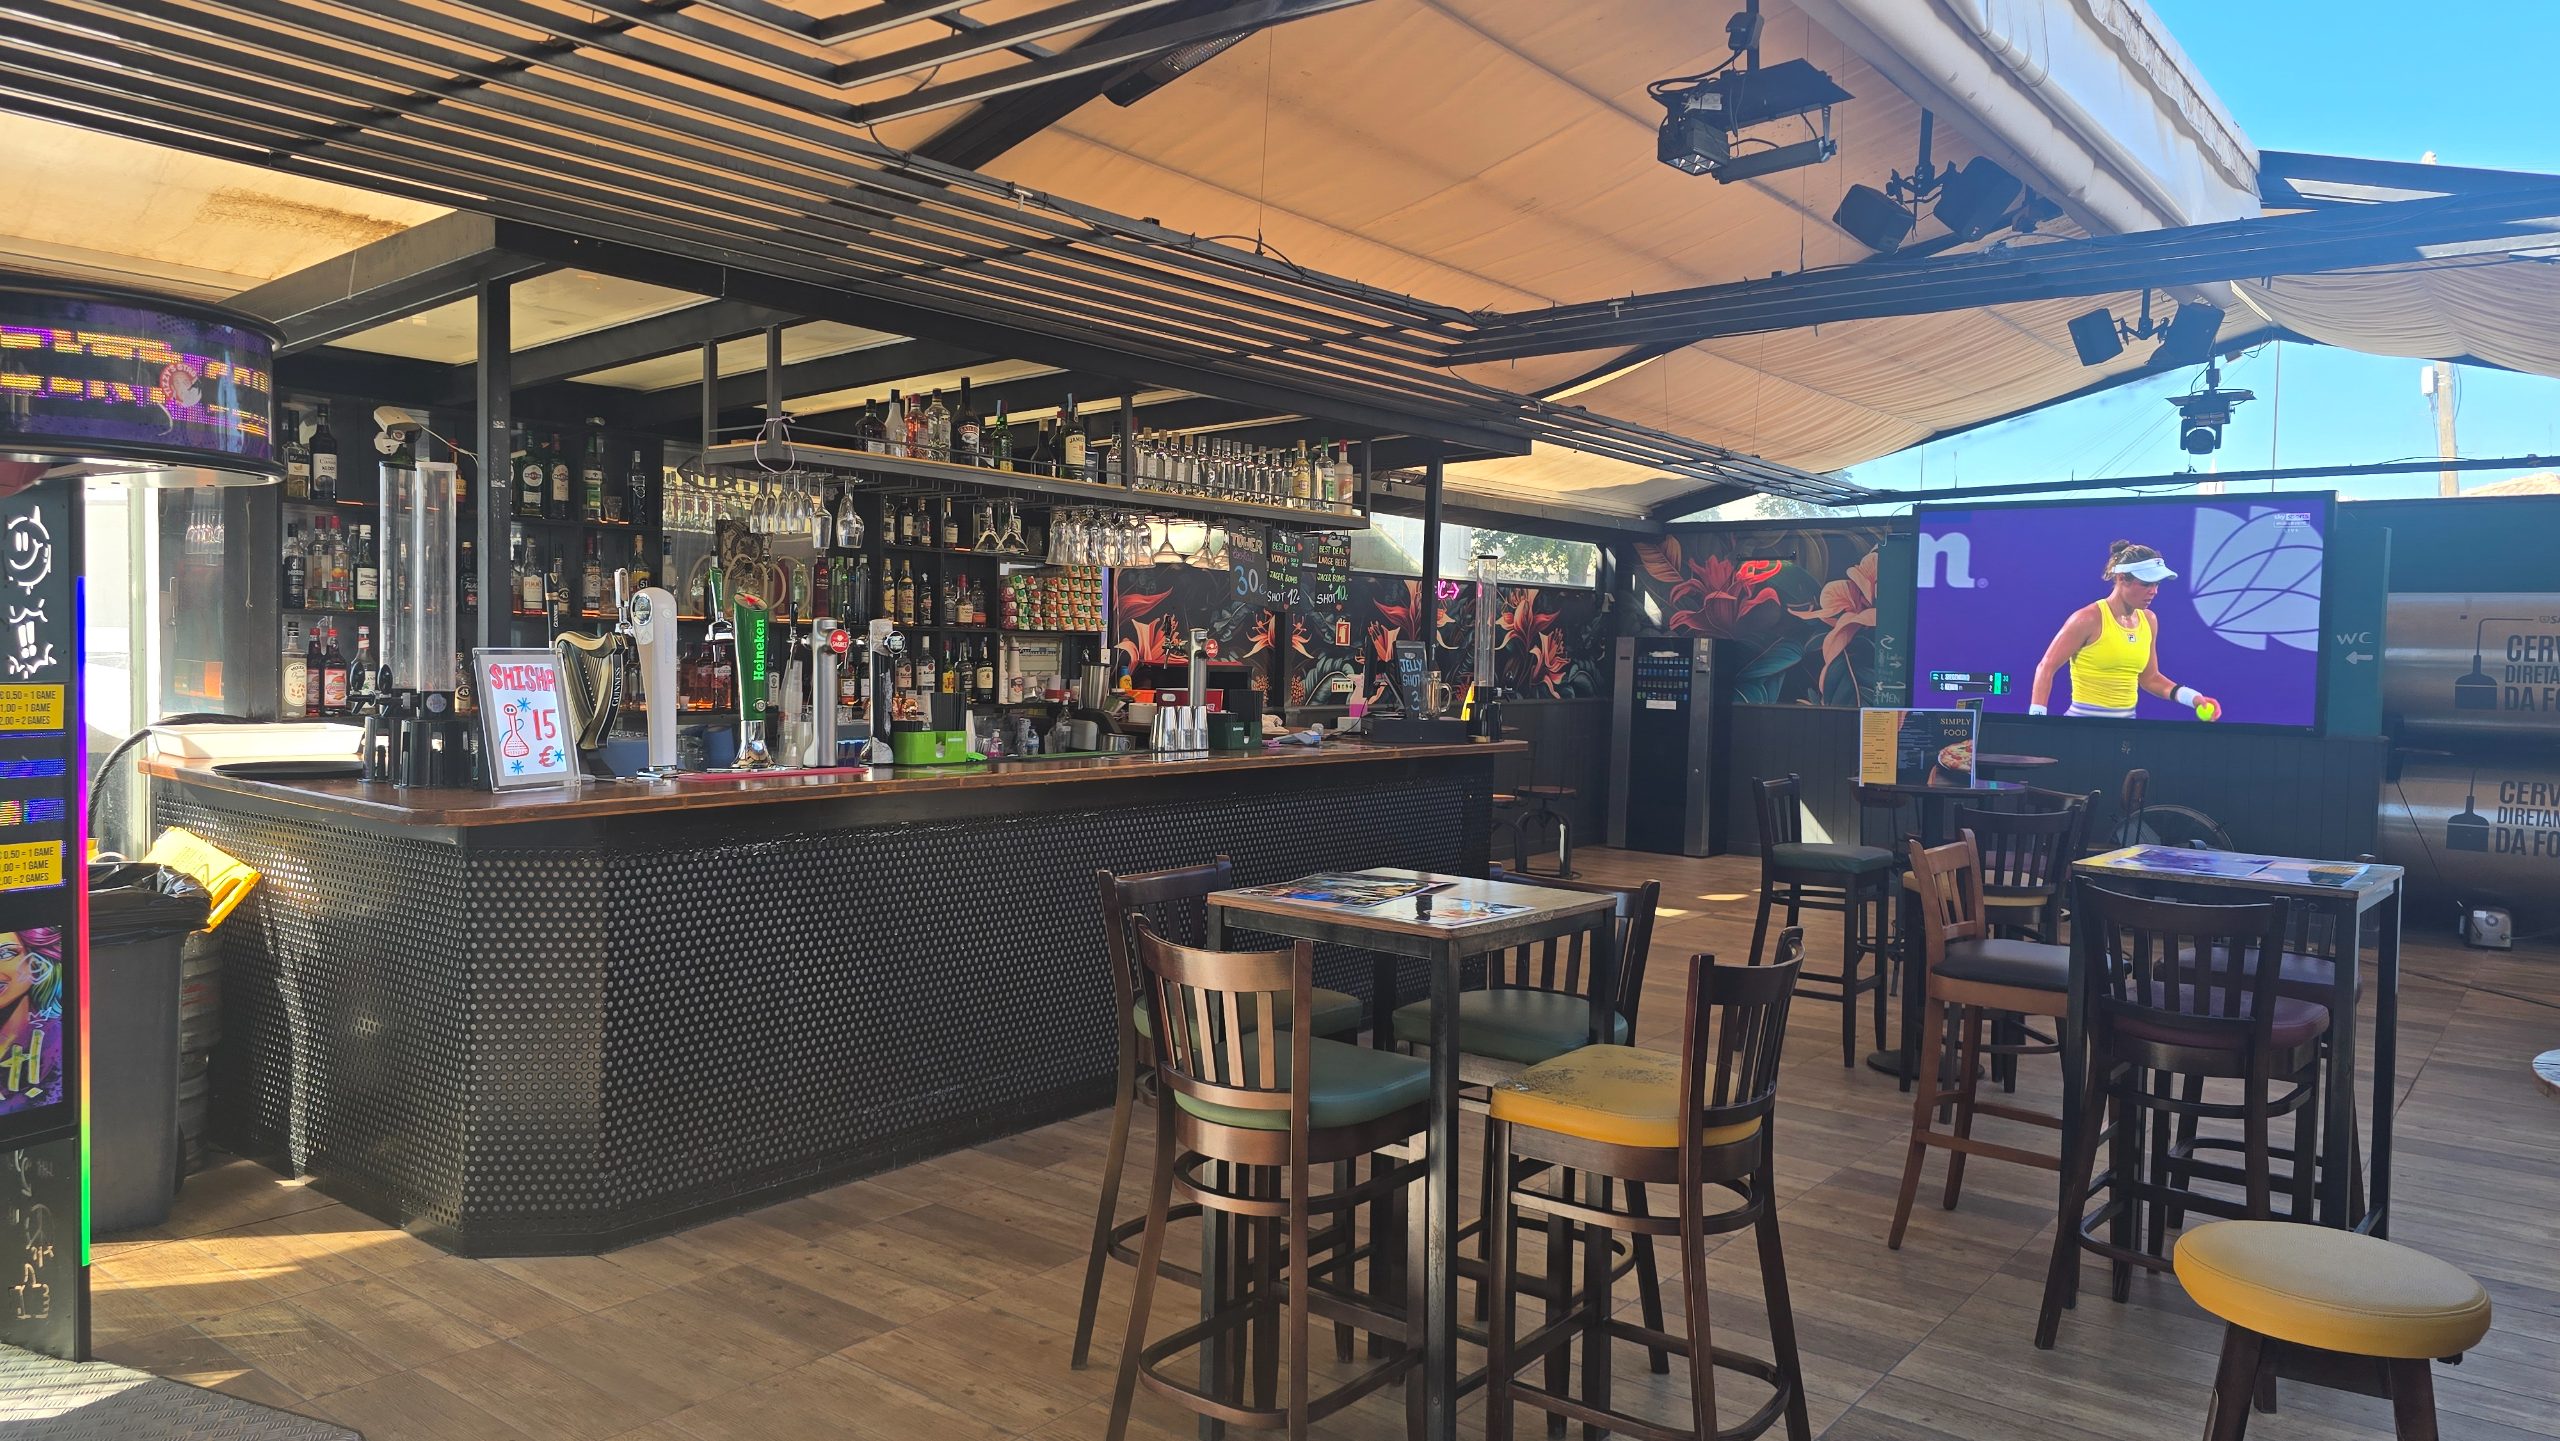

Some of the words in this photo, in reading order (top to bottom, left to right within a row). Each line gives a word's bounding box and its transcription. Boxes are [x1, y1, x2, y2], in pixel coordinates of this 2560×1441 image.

[1266, 591, 1286, 602] SHOT
[2336, 631, 2374, 645] WC
[753, 619, 765, 681] Heineken
[1400, 659, 1423, 673] JELLY
[489, 663, 557, 692] SHISHA
[459, 686, 469, 696] 43
[611, 667, 622, 707] GUINNESS
[36, 690, 56, 700] GAME
[2504, 686, 2536, 712] DA
[31, 702, 51, 711] GAME
[27, 715, 50, 725] GAMES
[1940, 717, 1971, 726] SIMPLY
[1943, 728, 1968, 737] FOOD
[2495, 826, 2527, 856] DA
[34, 846, 54, 857] GAME
[28, 859, 49, 870] GAME
[25, 872, 49, 883] GAMES
